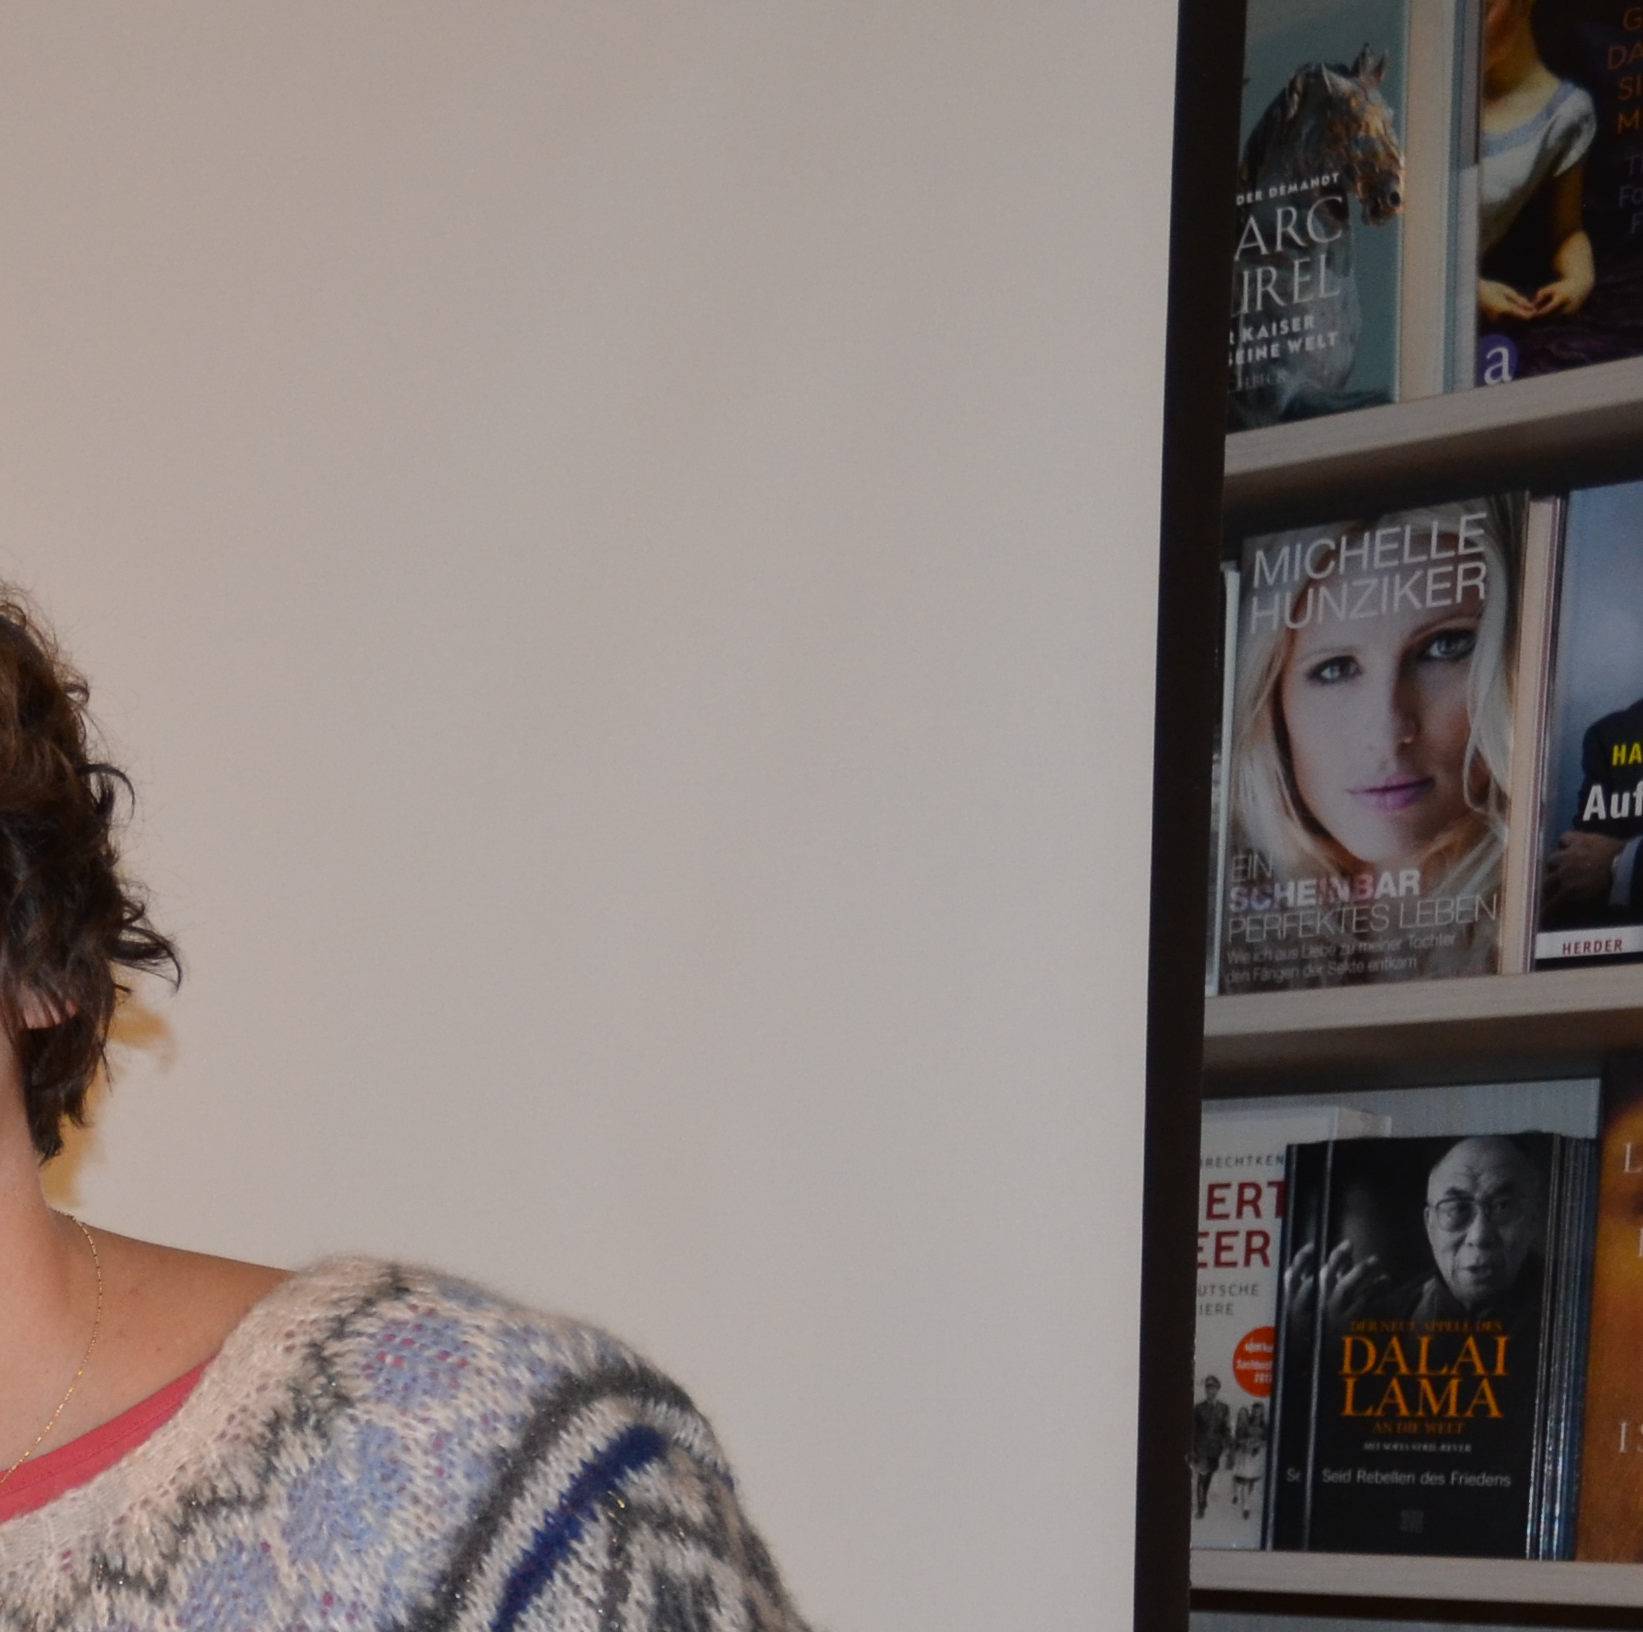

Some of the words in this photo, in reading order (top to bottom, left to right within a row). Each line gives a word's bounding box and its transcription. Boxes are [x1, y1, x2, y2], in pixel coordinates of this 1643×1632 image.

[1269, 172, 1341, 199] DEMANDT
[1240, 315, 1315, 342] KAISER
[1287, 331, 1339, 355] WELT
[1252, 511, 1487, 589] MICHELLE
[1250, 560, 1487, 636] HUNZIKER
[1230, 855, 1273, 883] EIN
[1229, 868, 1421, 912] SCHEINBAR
[1227, 904, 1390, 943] PERFEKTES
[1398, 894, 1498, 930] LEBEN
[1275, 948, 1299, 961] aus
[1408, 933, 1456, 949] Tochter
[1560, 937, 1624, 956] HERDER
[1198, 1283, 1260, 1297] UTSCHE
[1340, 1335, 1510, 1376] DALAI
[1341, 1376, 1504, 1419] LAMA
[1372, 1421, 1393, 1435] AN
[1396, 1421, 1419, 1435] DIE
[1425, 1421, 1466, 1435] WELT
[1322, 1468, 1351, 1484] Seid
[1357, 1469, 1415, 1485] Rebellen
[1420, 1471, 1445, 1486] des
[1450, 1471, 1511, 1488] Friedens
